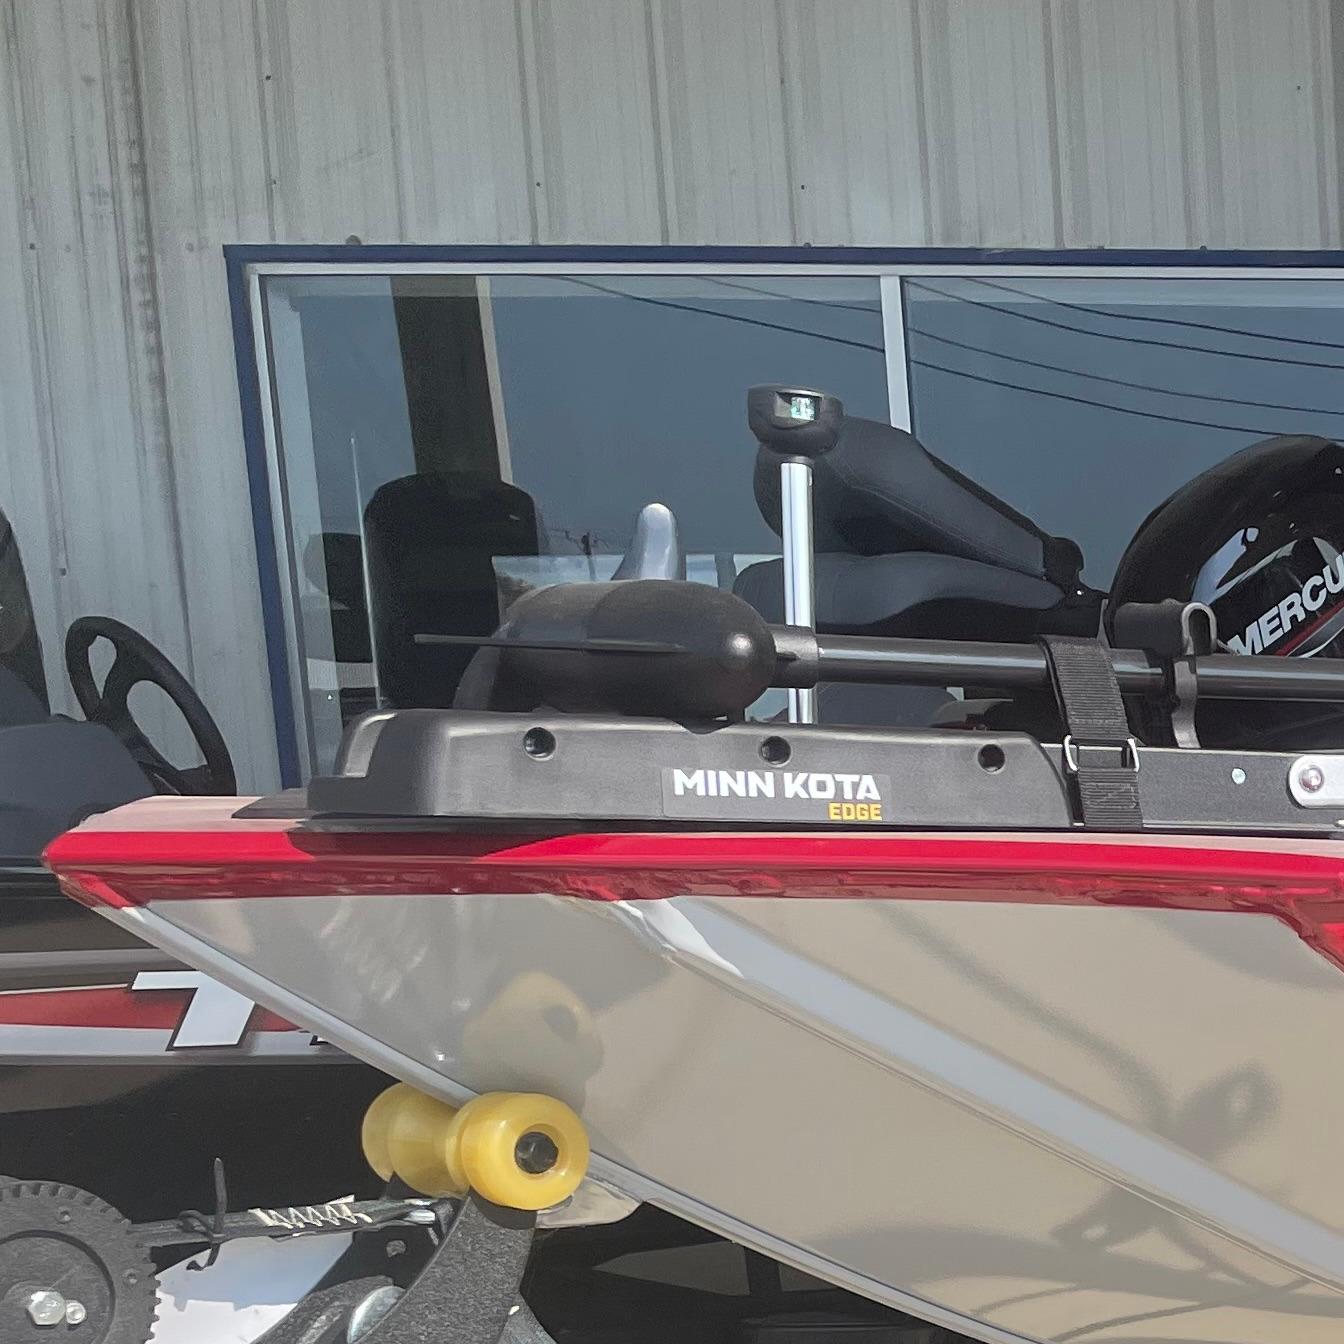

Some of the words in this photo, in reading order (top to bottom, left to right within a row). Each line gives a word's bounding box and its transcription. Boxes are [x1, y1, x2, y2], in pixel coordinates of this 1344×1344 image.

[673, 769, 776, 798] MINN
[784, 772, 882, 800] KOTA
[828, 802, 883, 821] EDGE
